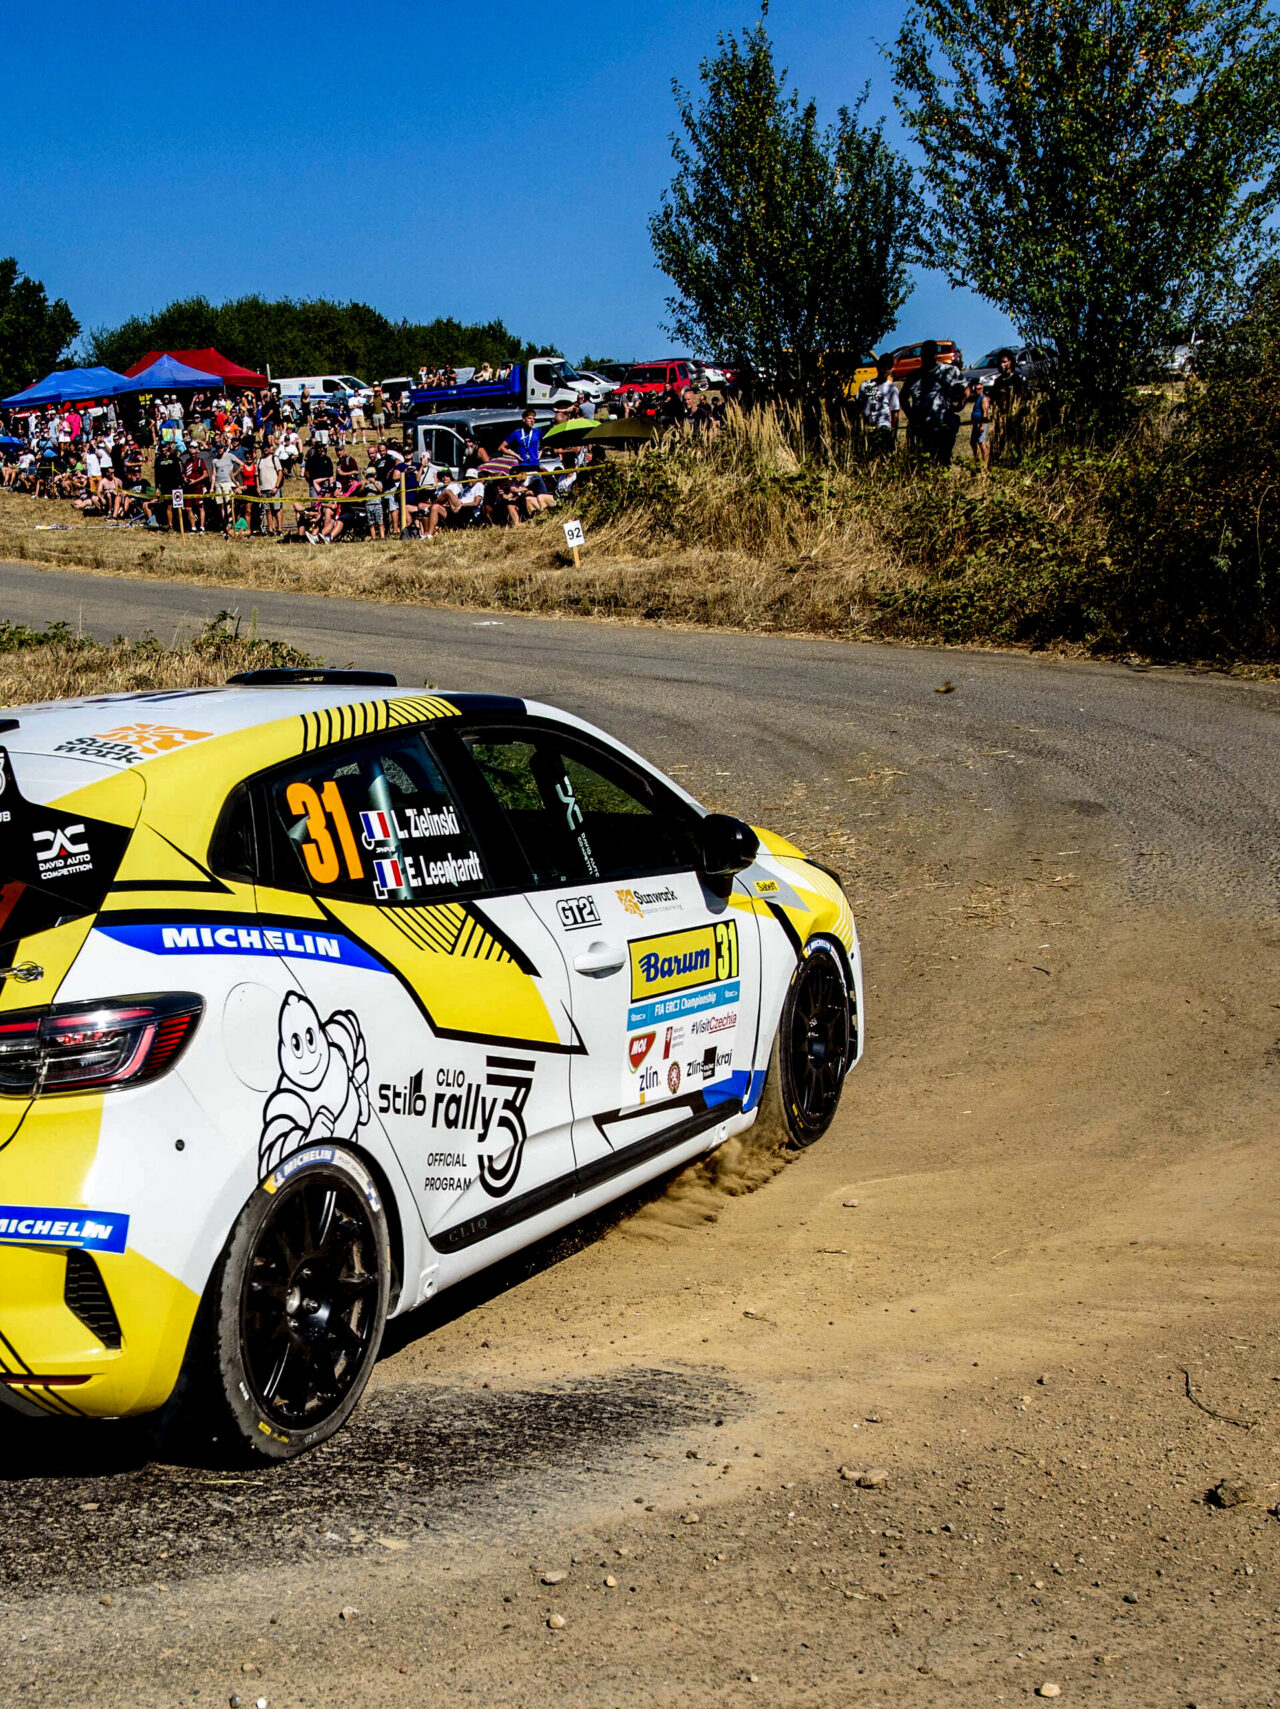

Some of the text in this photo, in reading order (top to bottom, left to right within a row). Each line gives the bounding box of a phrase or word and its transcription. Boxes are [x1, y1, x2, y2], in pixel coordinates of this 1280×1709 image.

[567, 527, 582, 540] 92
[65, 737, 133, 751] Sun
[53, 744, 144, 764] work
[390, 806, 461, 839] L. Zielinski
[286, 780, 365, 885] 31
[39, 854, 91, 871] DAVID AUTO
[41, 863, 93, 880] COMPETITION
[404, 851, 484, 887] E. Leenhardt
[633, 886, 678, 905] Sunwork
[161, 927, 341, 958] MICHELIN
[716, 921, 738, 981] 31
[638, 948, 710, 983] Barum
[654, 1004, 664, 1016] FIA
[630, 1038, 648, 1056] MOL
[436, 1068, 466, 1089] CLIO
[431, 1082, 499, 1143] rally
[427, 1153, 468, 1168] OFFICIAL
[424, 1177, 472, 1192] PROGRAM
